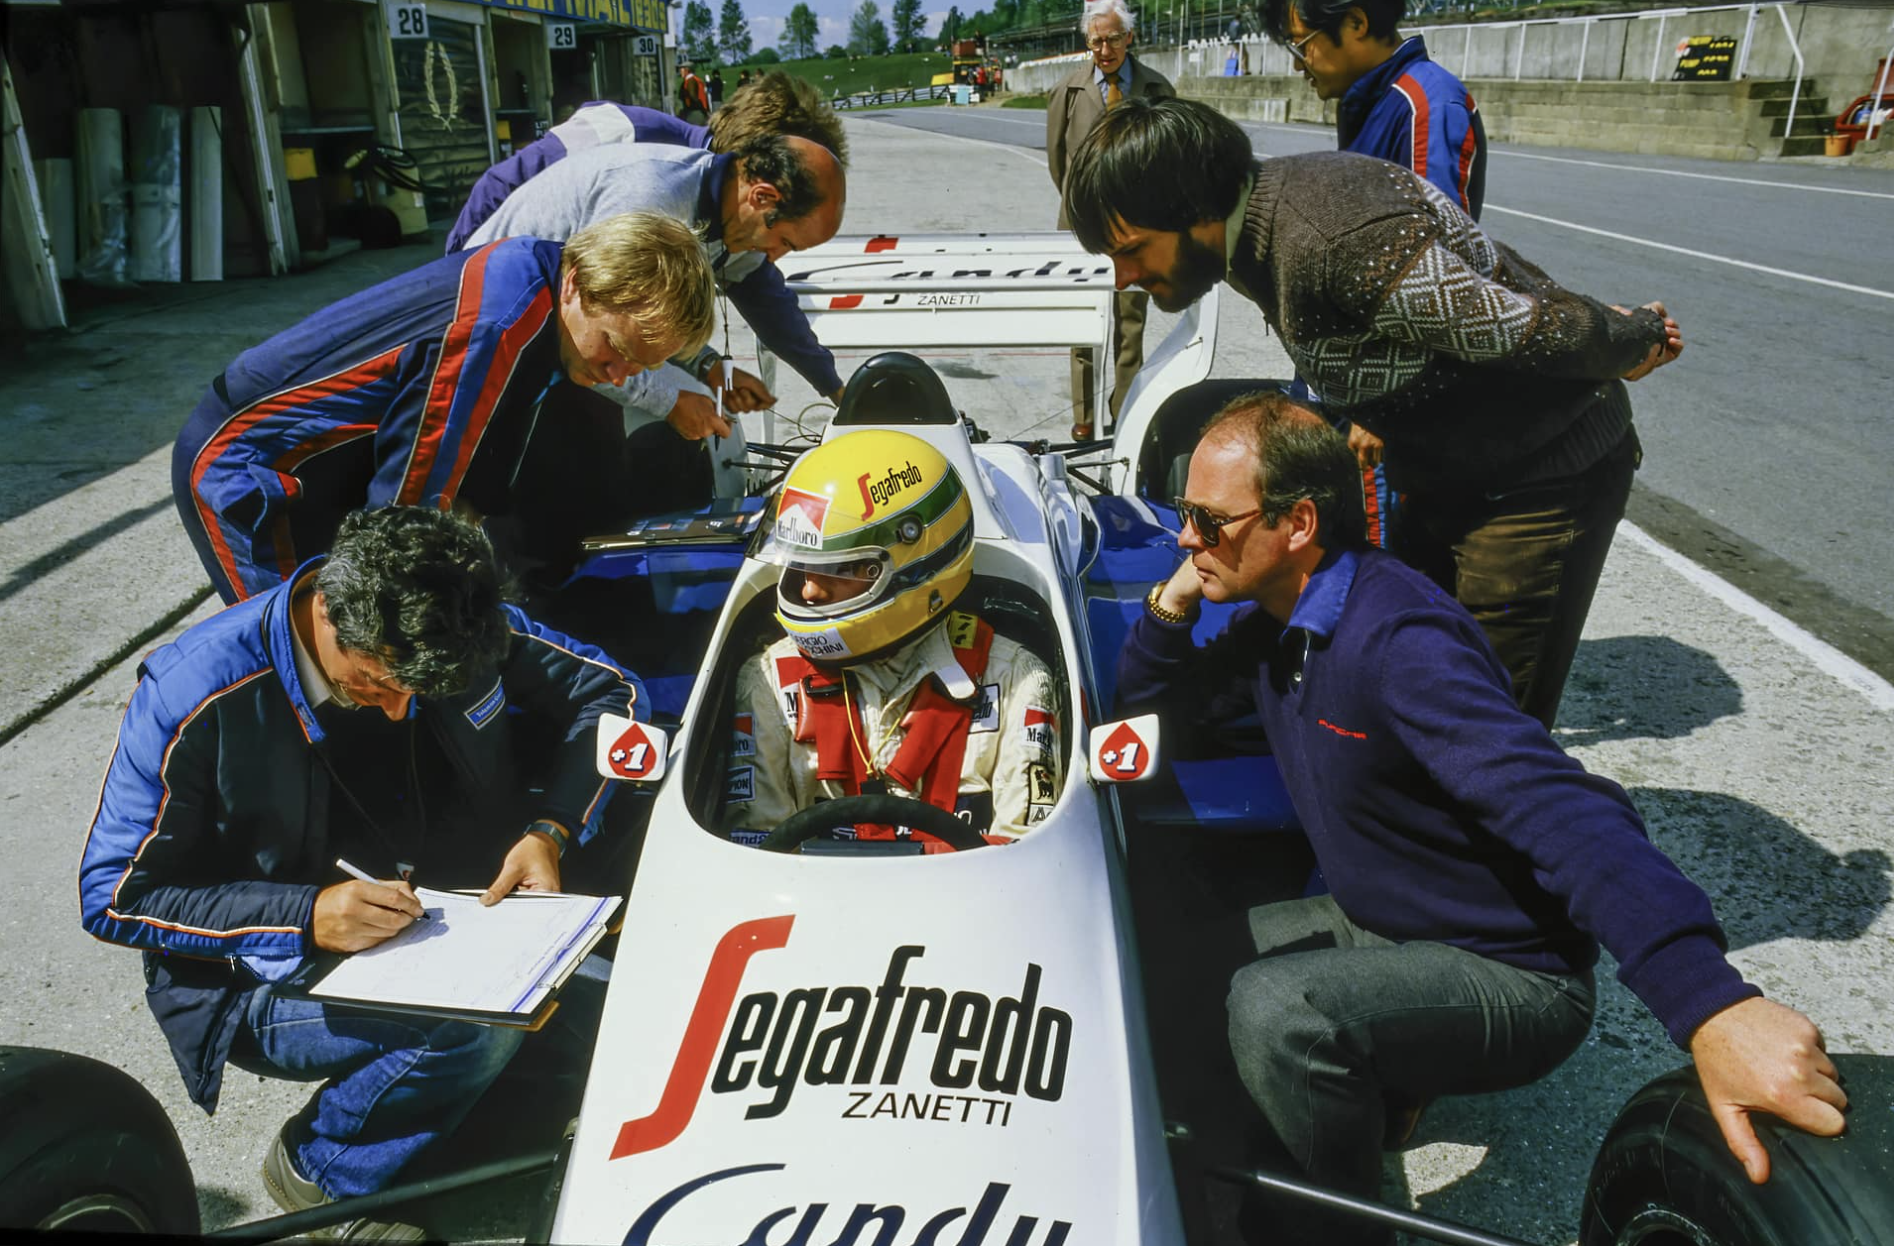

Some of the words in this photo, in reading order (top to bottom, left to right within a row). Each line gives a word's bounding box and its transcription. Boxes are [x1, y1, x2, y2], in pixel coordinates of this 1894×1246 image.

[398, 8, 424, 35] 28
[554, 27, 574, 46] 29
[639, 38, 655, 53] 30
[917, 294, 981, 306] ZANETTI
[857, 461, 923, 522] Segafredo
[795, 635, 827, 646] ERGIO
[611, 743, 649, 771] +1
[1102, 742, 1140, 773] +1
[609, 914, 1074, 1161] Segafredo
[841, 1091, 1012, 1128] ZANETTI
